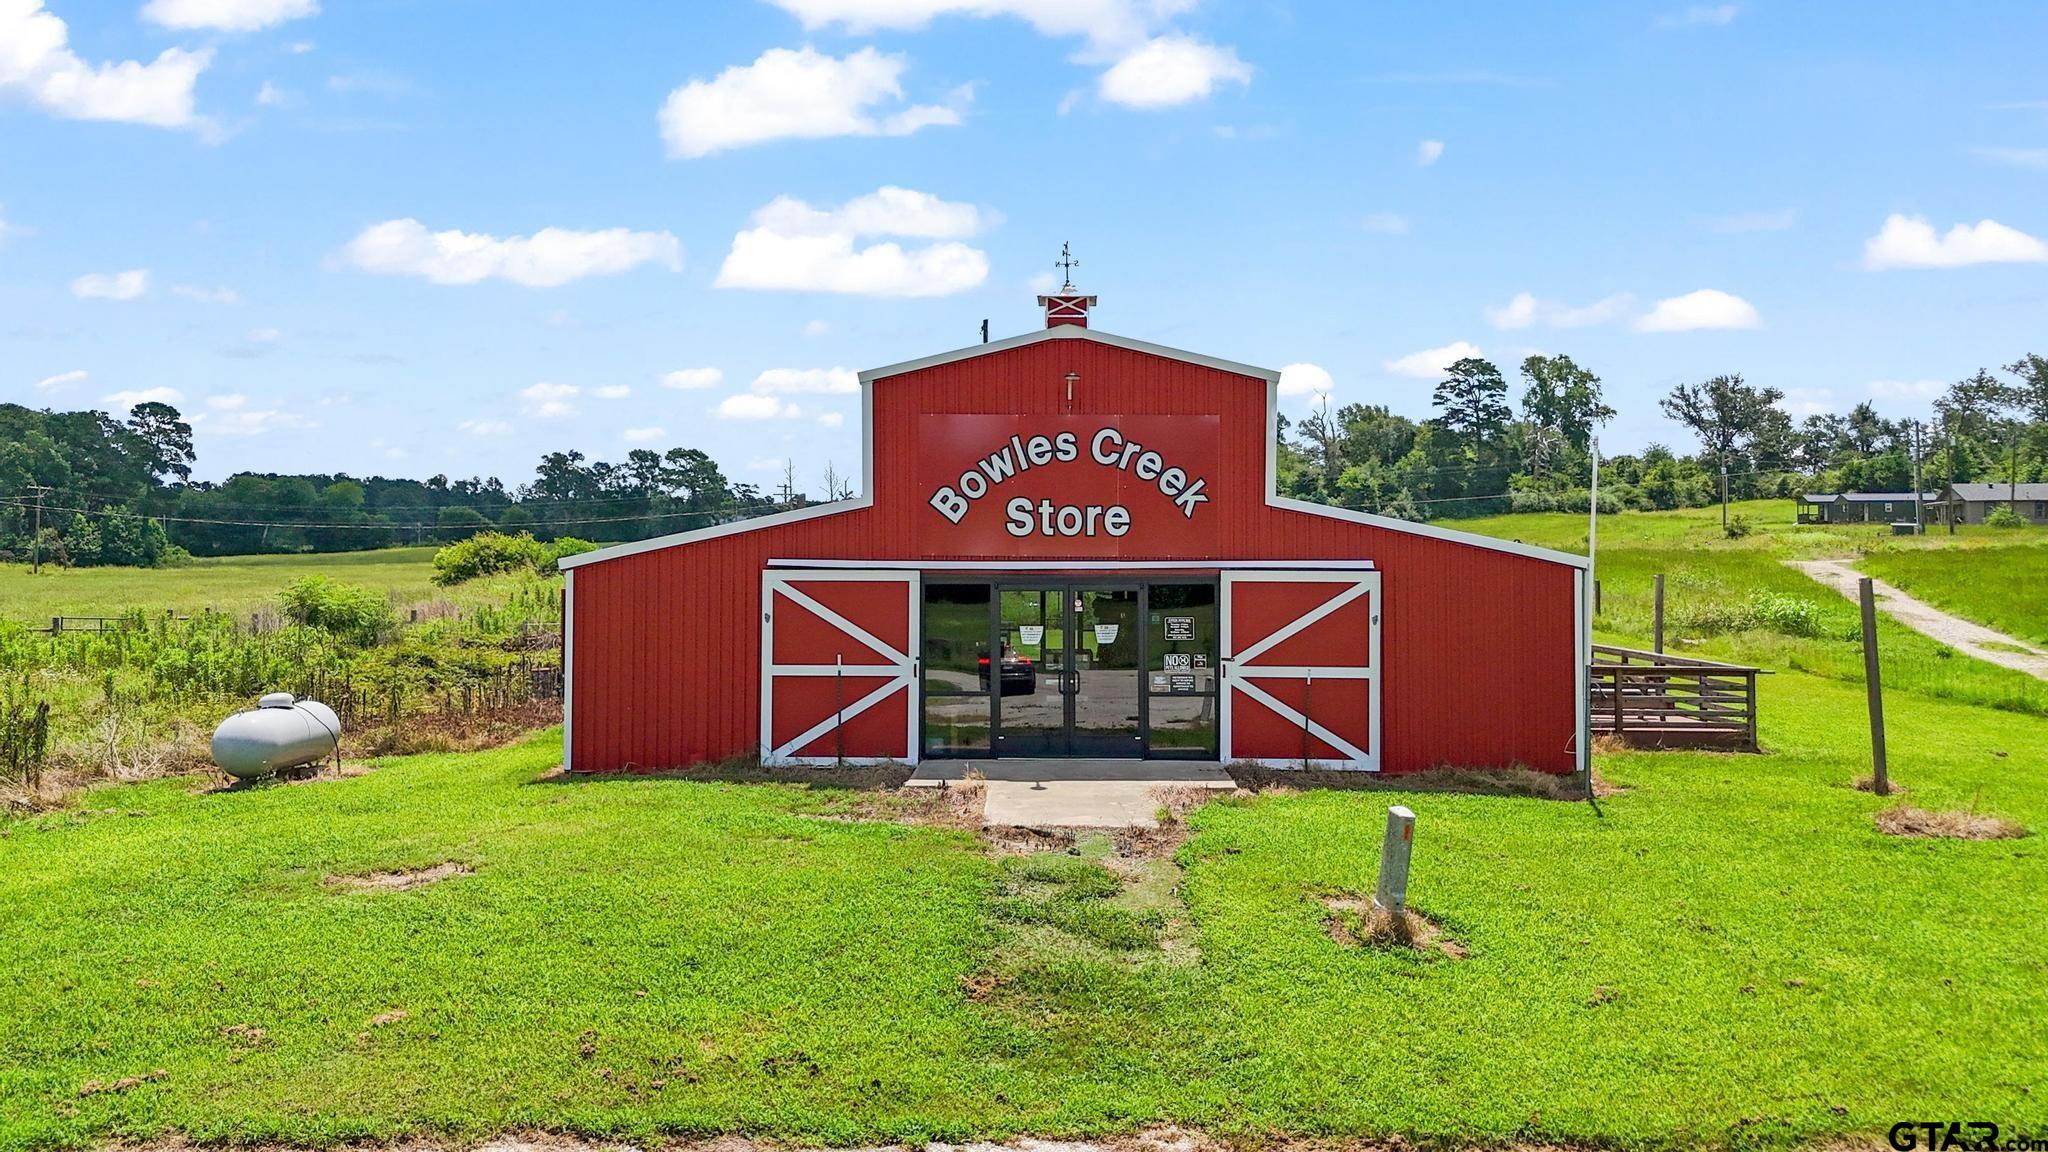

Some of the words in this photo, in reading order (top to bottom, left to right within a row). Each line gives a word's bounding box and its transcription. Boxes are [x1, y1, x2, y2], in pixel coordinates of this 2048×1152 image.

[929, 432, 1078, 524] Bowles
[1092, 428, 1210, 518] Creek
[1006, 497, 1131, 537] Store
[1166, 655, 1179, 666] NO
